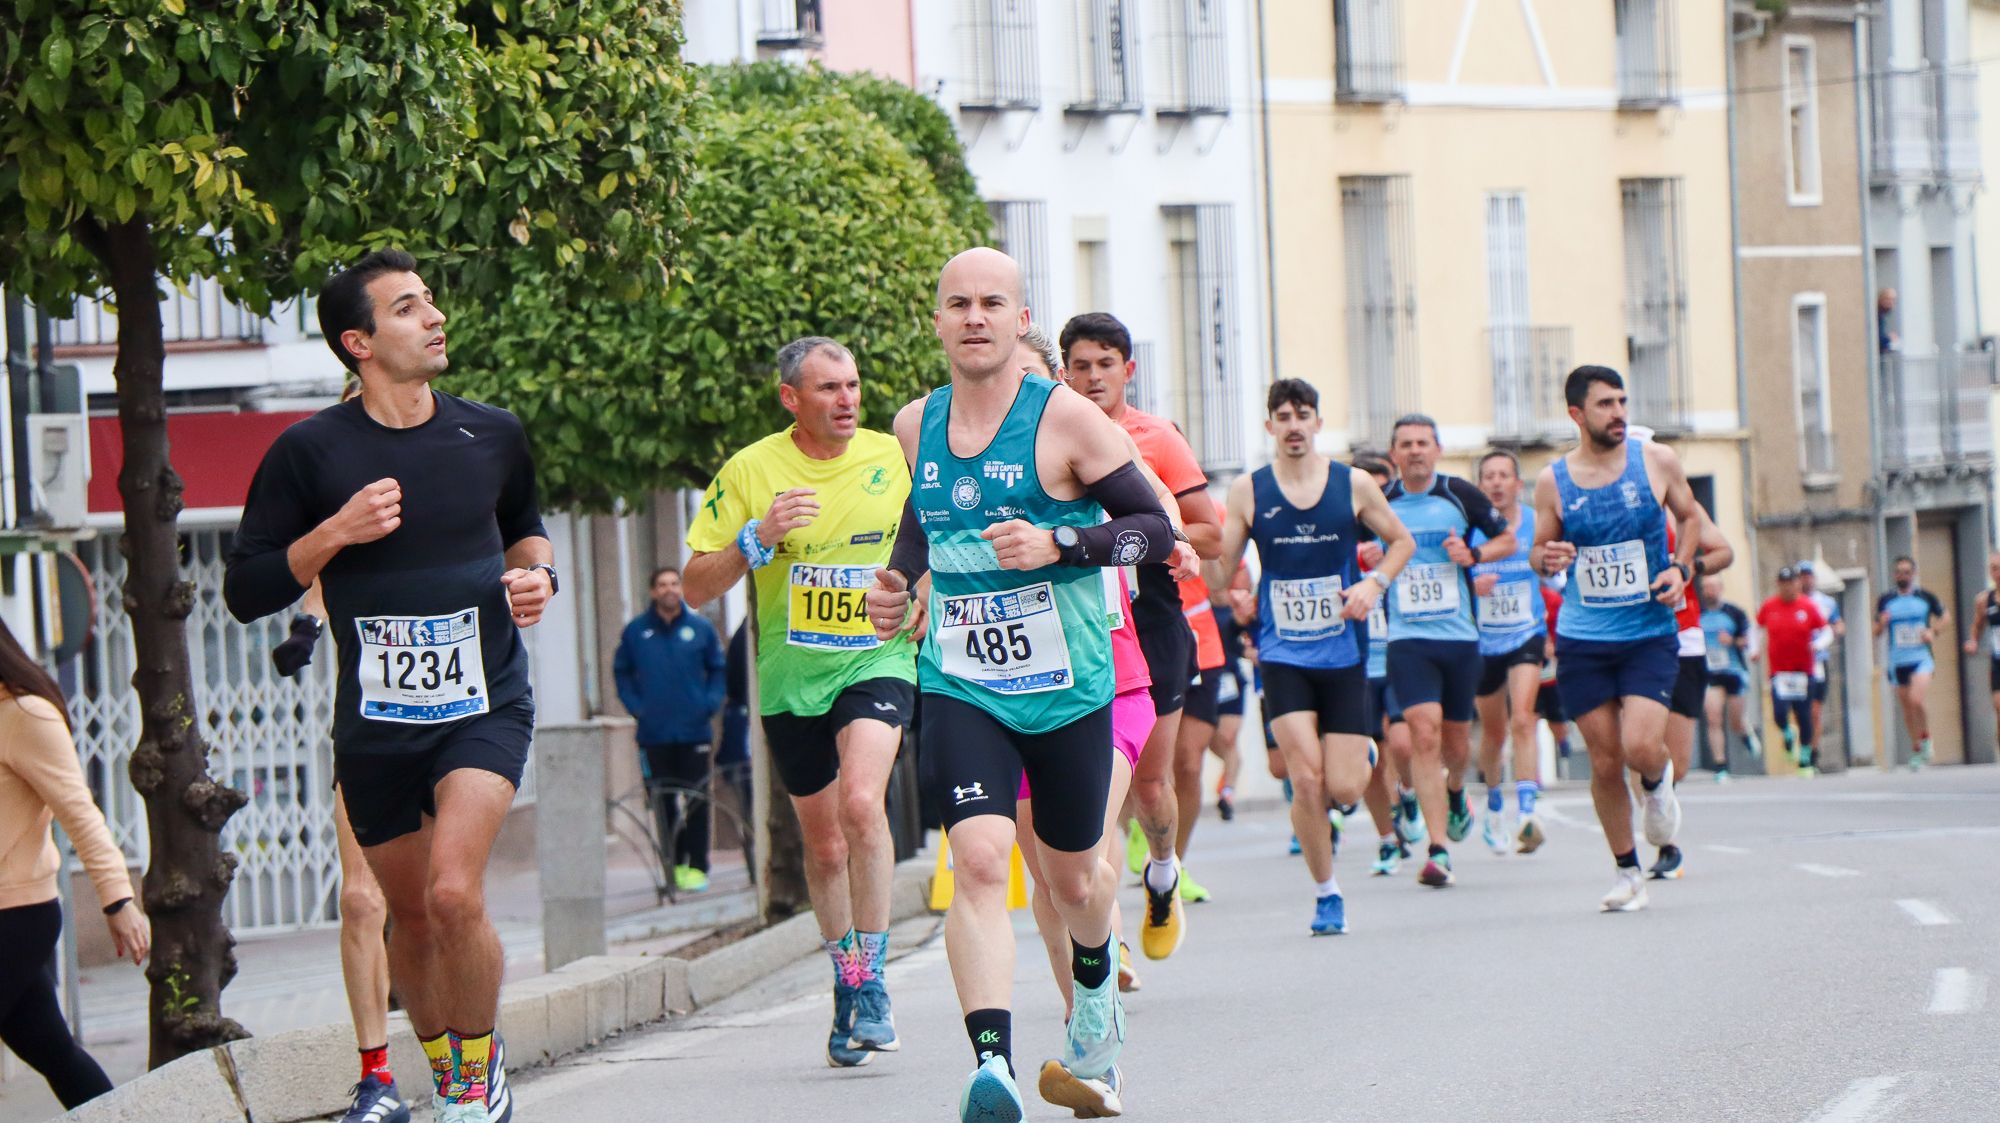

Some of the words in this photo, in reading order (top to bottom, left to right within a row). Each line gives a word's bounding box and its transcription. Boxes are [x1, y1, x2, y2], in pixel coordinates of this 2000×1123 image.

[1585, 563, 1636, 588] 1375
[1410, 582, 1443, 603] 939
[803, 590, 867, 623] 1054
[953, 598, 984, 625] 21K
[1282, 599, 1332, 621] 1376
[1490, 599, 1520, 618] 204
[375, 619, 413, 646] 21K
[966, 622, 1032, 666] 485
[378, 647, 464, 690] 1234
